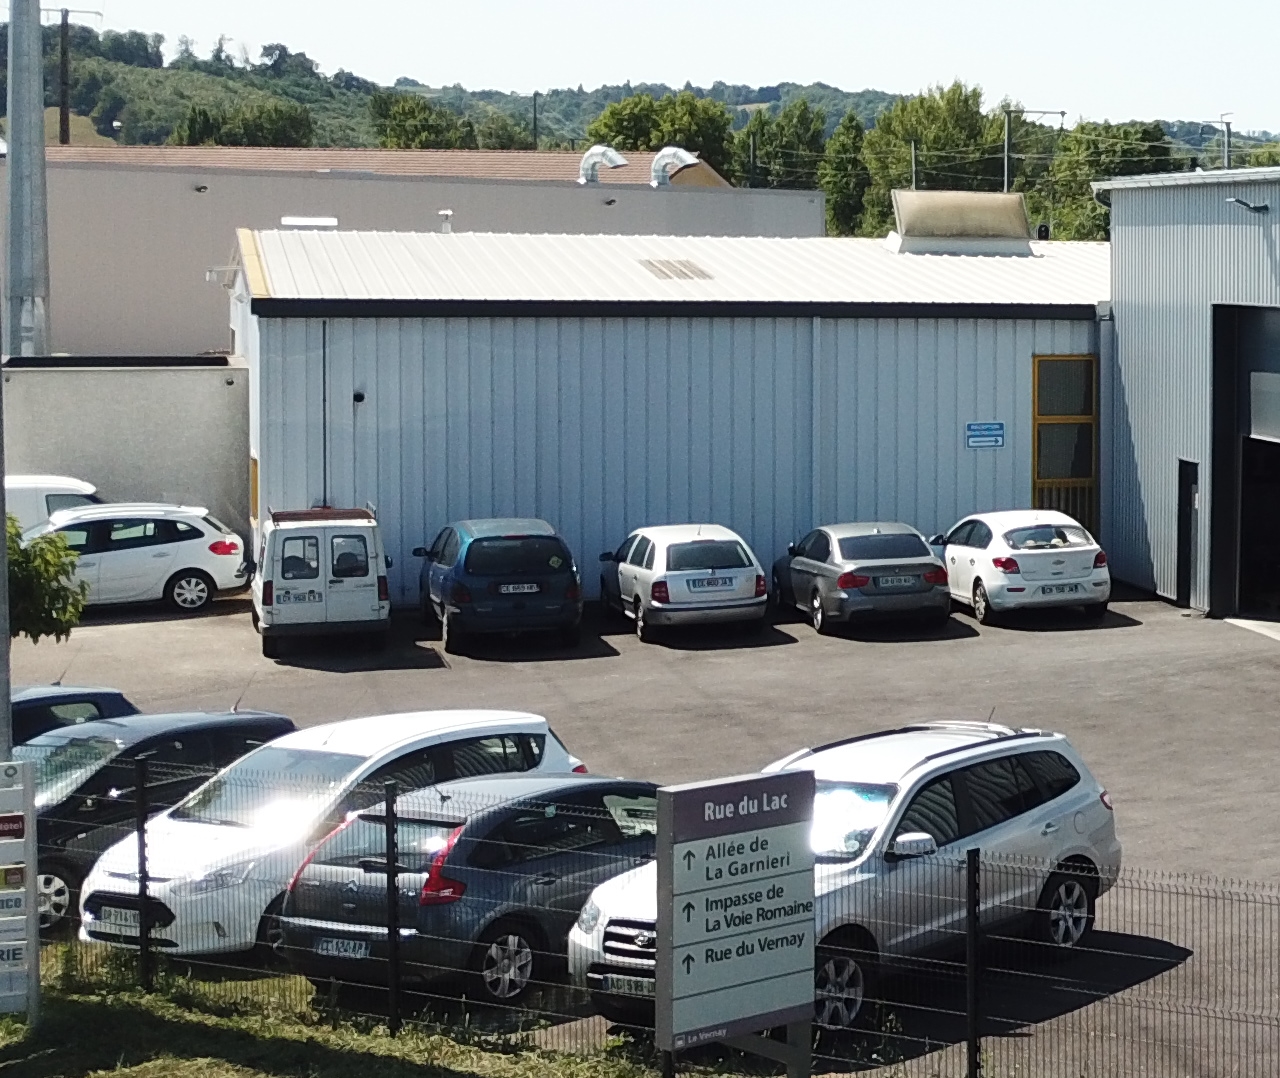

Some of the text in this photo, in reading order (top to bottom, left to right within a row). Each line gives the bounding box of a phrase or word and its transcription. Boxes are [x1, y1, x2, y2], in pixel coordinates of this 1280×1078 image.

[704, 792, 788, 821] Rue du Lac
[705, 835, 769, 861] Allée de
[705, 851, 790, 881] La Garnieri
[705, 883, 784, 913] Impasse de
[705, 899, 814, 933] La Voie Romaine
[705, 932, 806, 965] Rue du Vernay
